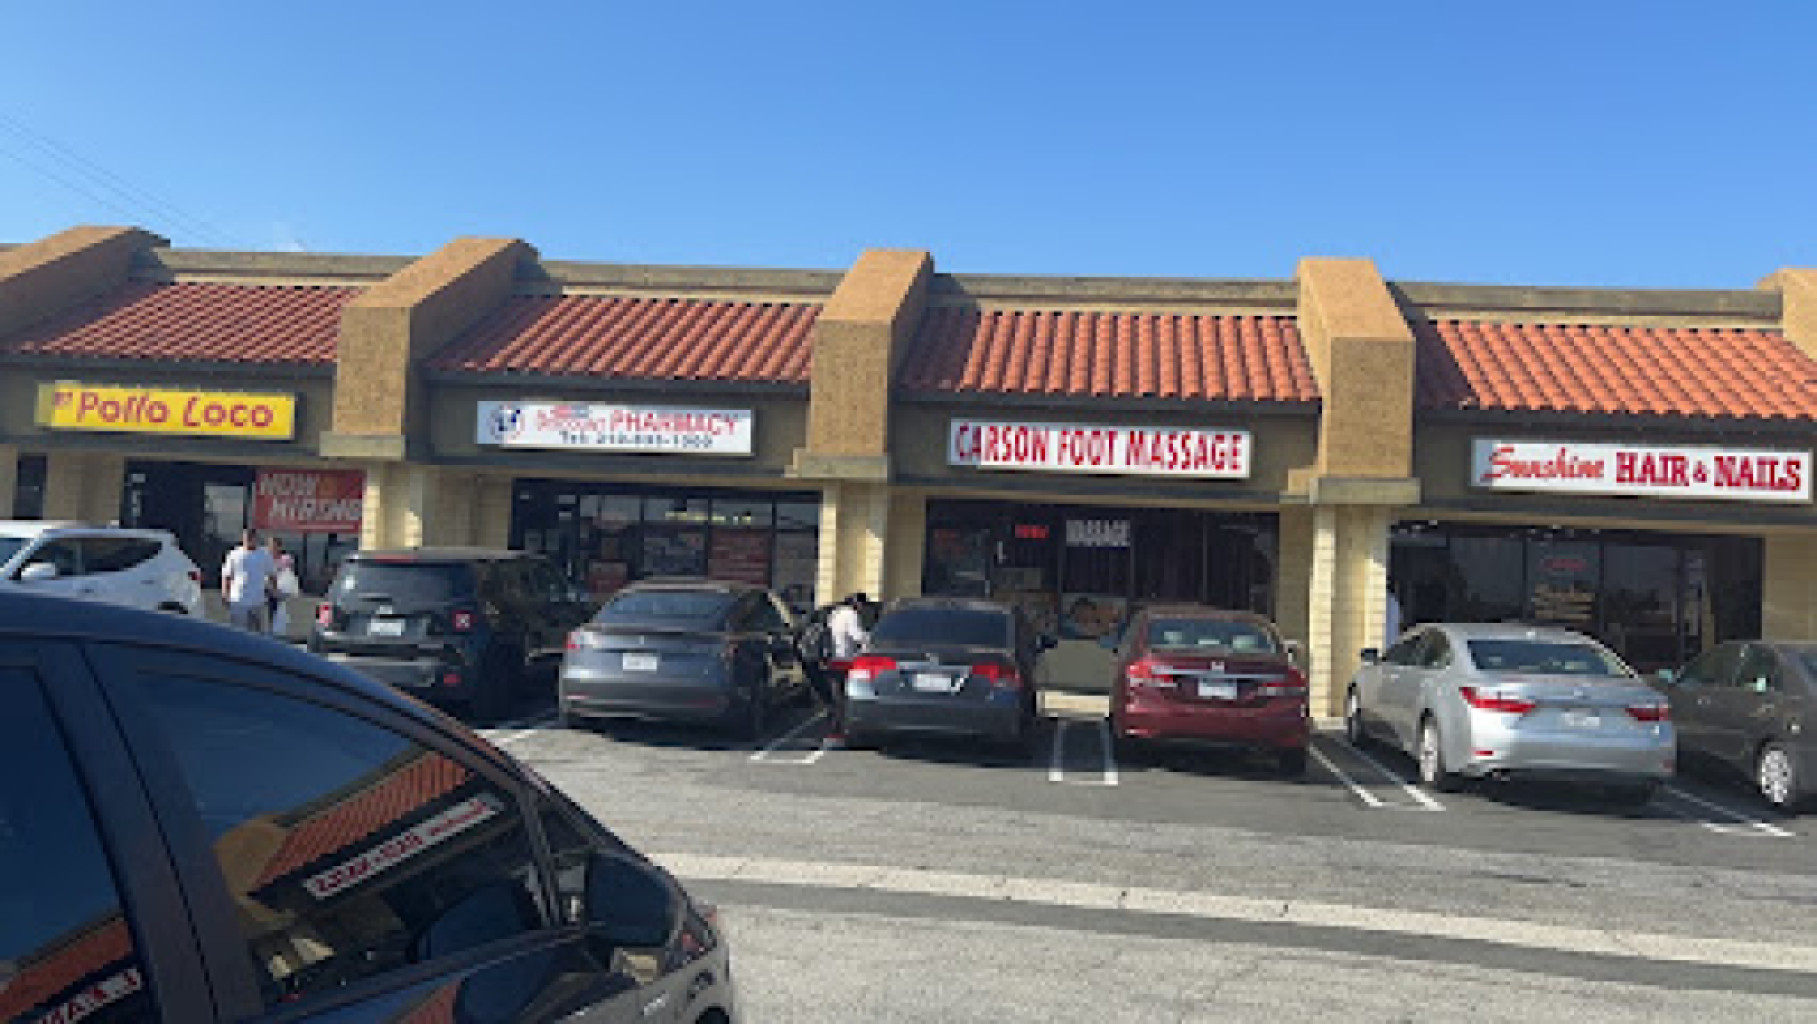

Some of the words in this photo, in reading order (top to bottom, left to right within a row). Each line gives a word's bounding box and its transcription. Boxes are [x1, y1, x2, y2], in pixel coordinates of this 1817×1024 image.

[76, 391, 170, 423] Pollo
[183, 396, 274, 427] Loco
[610, 409, 738, 435] PHARMACY
[954, 422, 1049, 462] CARSON
[1058, 427, 1118, 465] FOOT
[1126, 430, 1242, 470] MASSAGE
[1480, 446, 1604, 481] Sunshine
[1616, 452, 1689, 486] HAIR
[1692, 461, 1708, 482] &
[1714, 456, 1801, 490] NAILS
